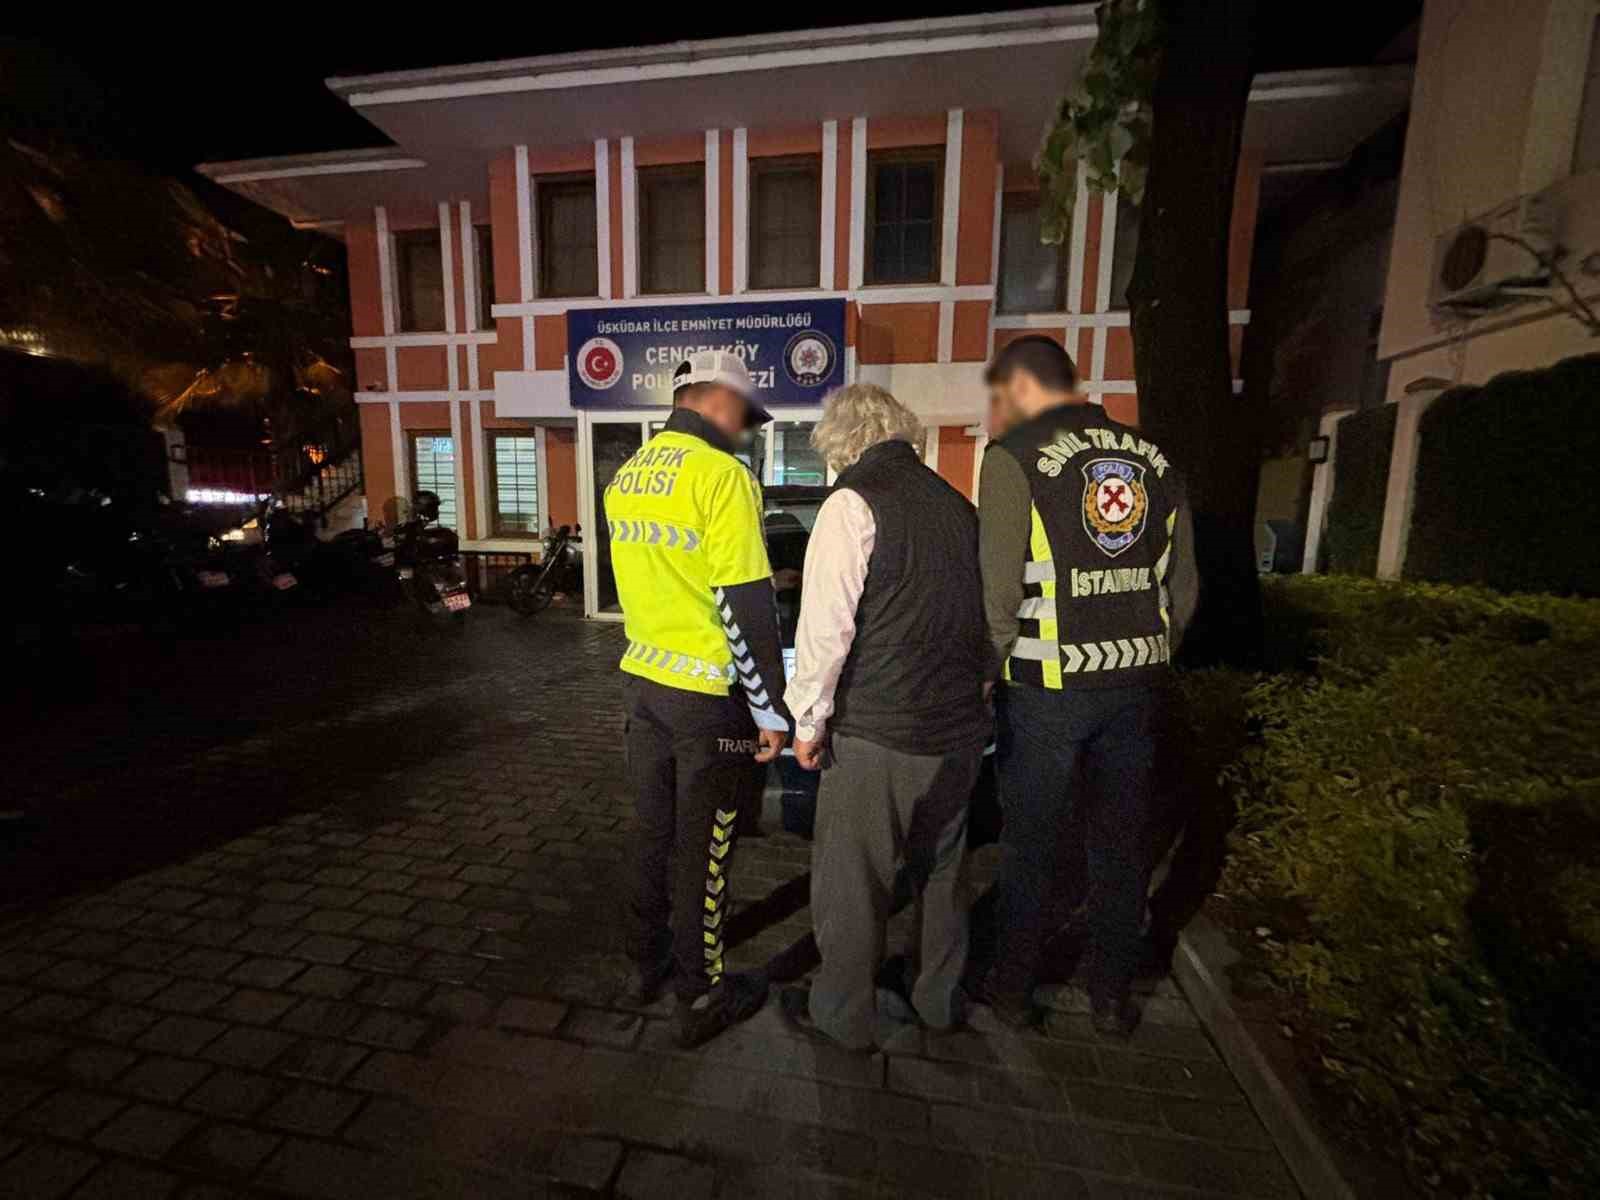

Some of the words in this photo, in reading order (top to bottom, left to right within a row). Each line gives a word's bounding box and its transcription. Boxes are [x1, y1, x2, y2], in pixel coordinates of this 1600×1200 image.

[597, 320, 650, 334] ÜSKÜDAR
[653, 318, 678, 332] İLÇE
[681, 316, 732, 331] EMNİYET
[736, 312, 812, 330] MÜDÜRLÜĞÜ
[632, 367, 674, 391] POLİ
[626, 446, 690, 468] RAFİK
[1071, 568, 1152, 597] İSTANBUL
